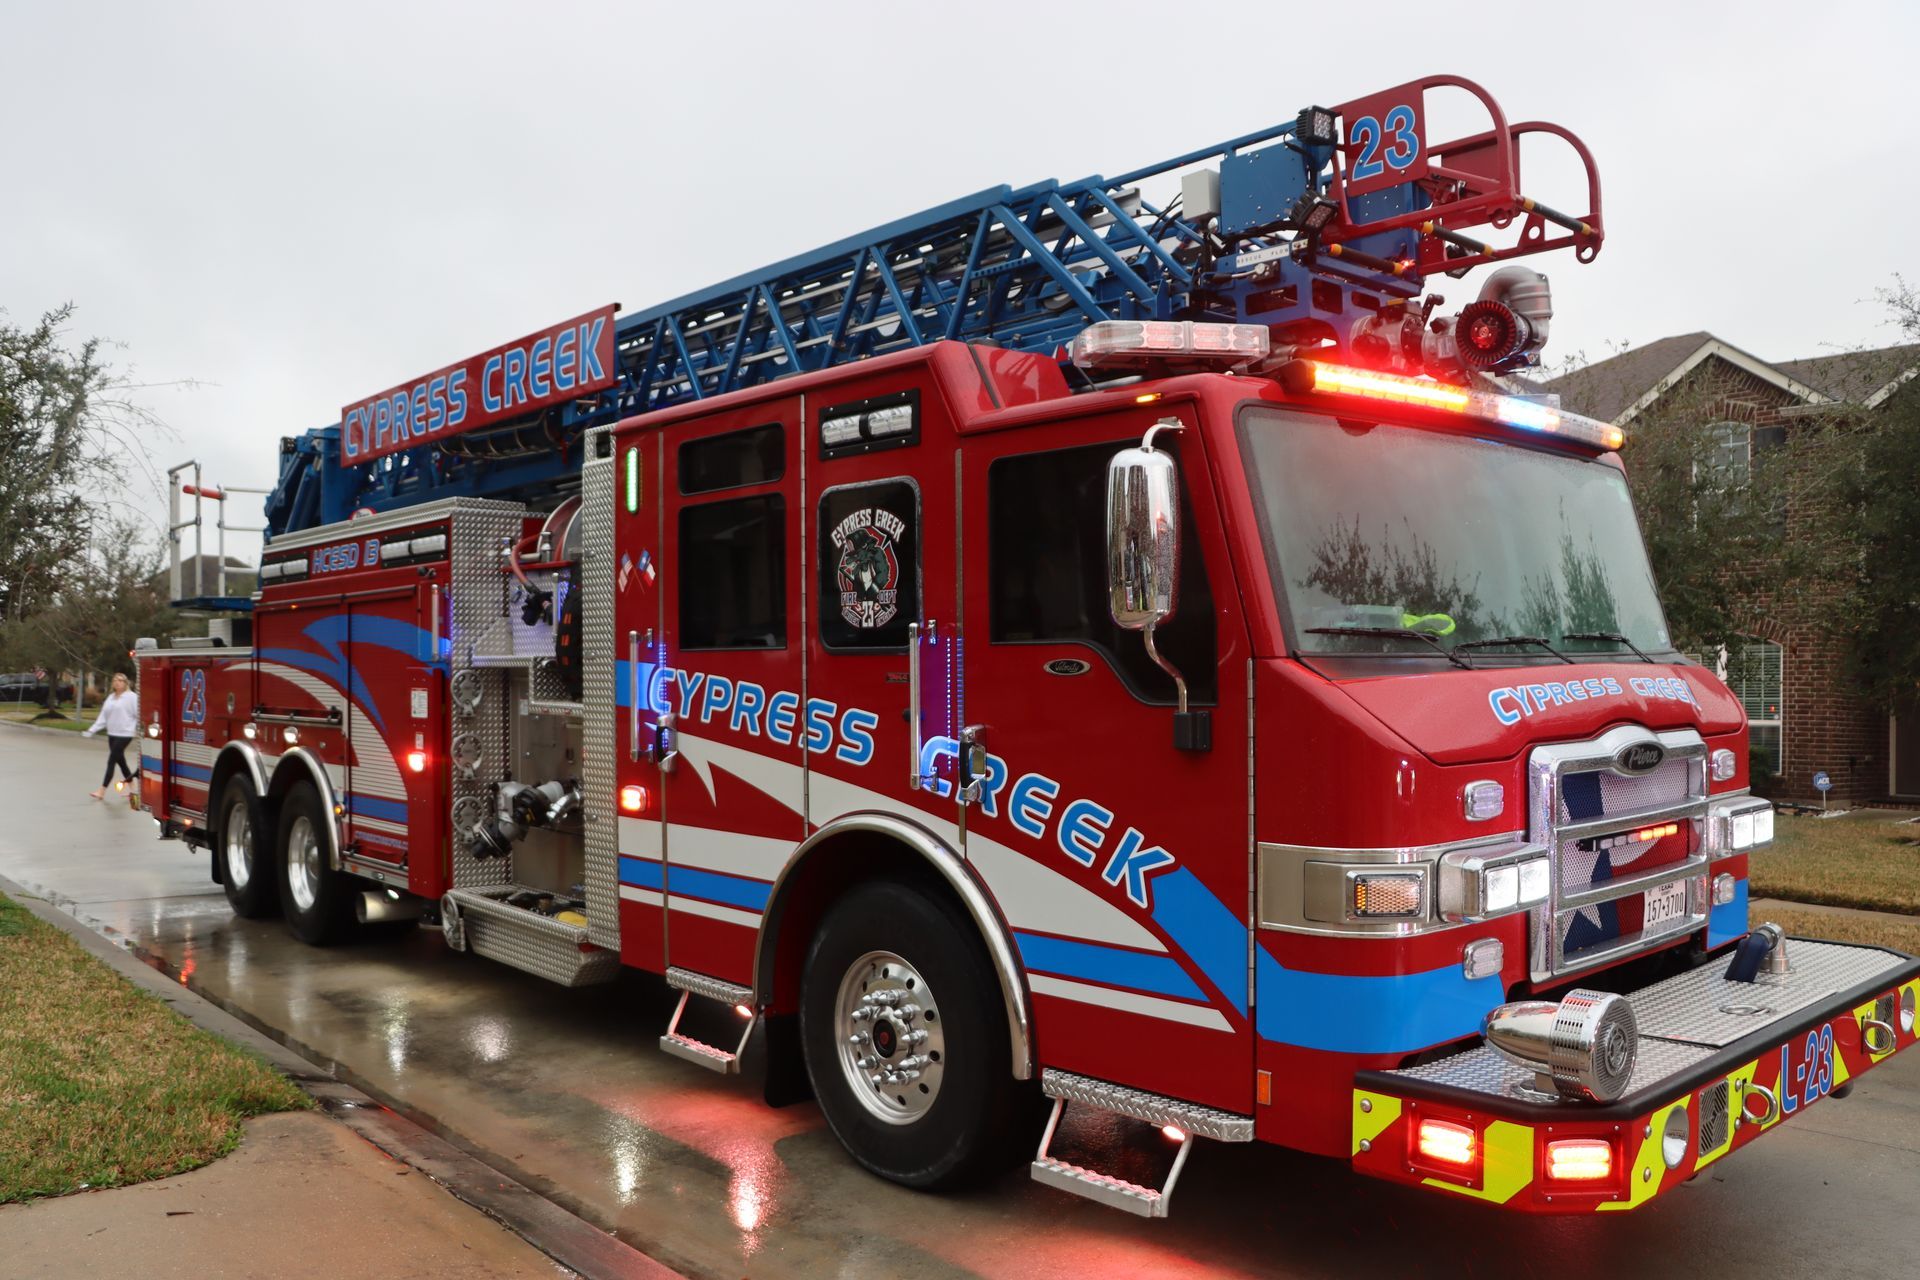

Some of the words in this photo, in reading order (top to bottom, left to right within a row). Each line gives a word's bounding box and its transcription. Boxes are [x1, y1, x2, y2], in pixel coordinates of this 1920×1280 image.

[1350, 104, 1419, 181] 23
[344, 367, 467, 458] CYPRESS
[482, 316, 607, 414] CREEK
[831, 508, 872, 548] CYPRESS
[874, 508, 905, 542] CREEK
[312, 542, 359, 574] HCESD
[841, 591, 858, 606] FIRE
[878, 589, 897, 604] DEPT
[862, 600, 874, 627] 23
[182, 668, 206, 725] 23
[1489, 677, 1623, 726] CYPRESS
[650, 666, 879, 766] CYPRESS
[919, 735, 1176, 909] CREEK
[1781, 1023, 1833, 1113] L-23
